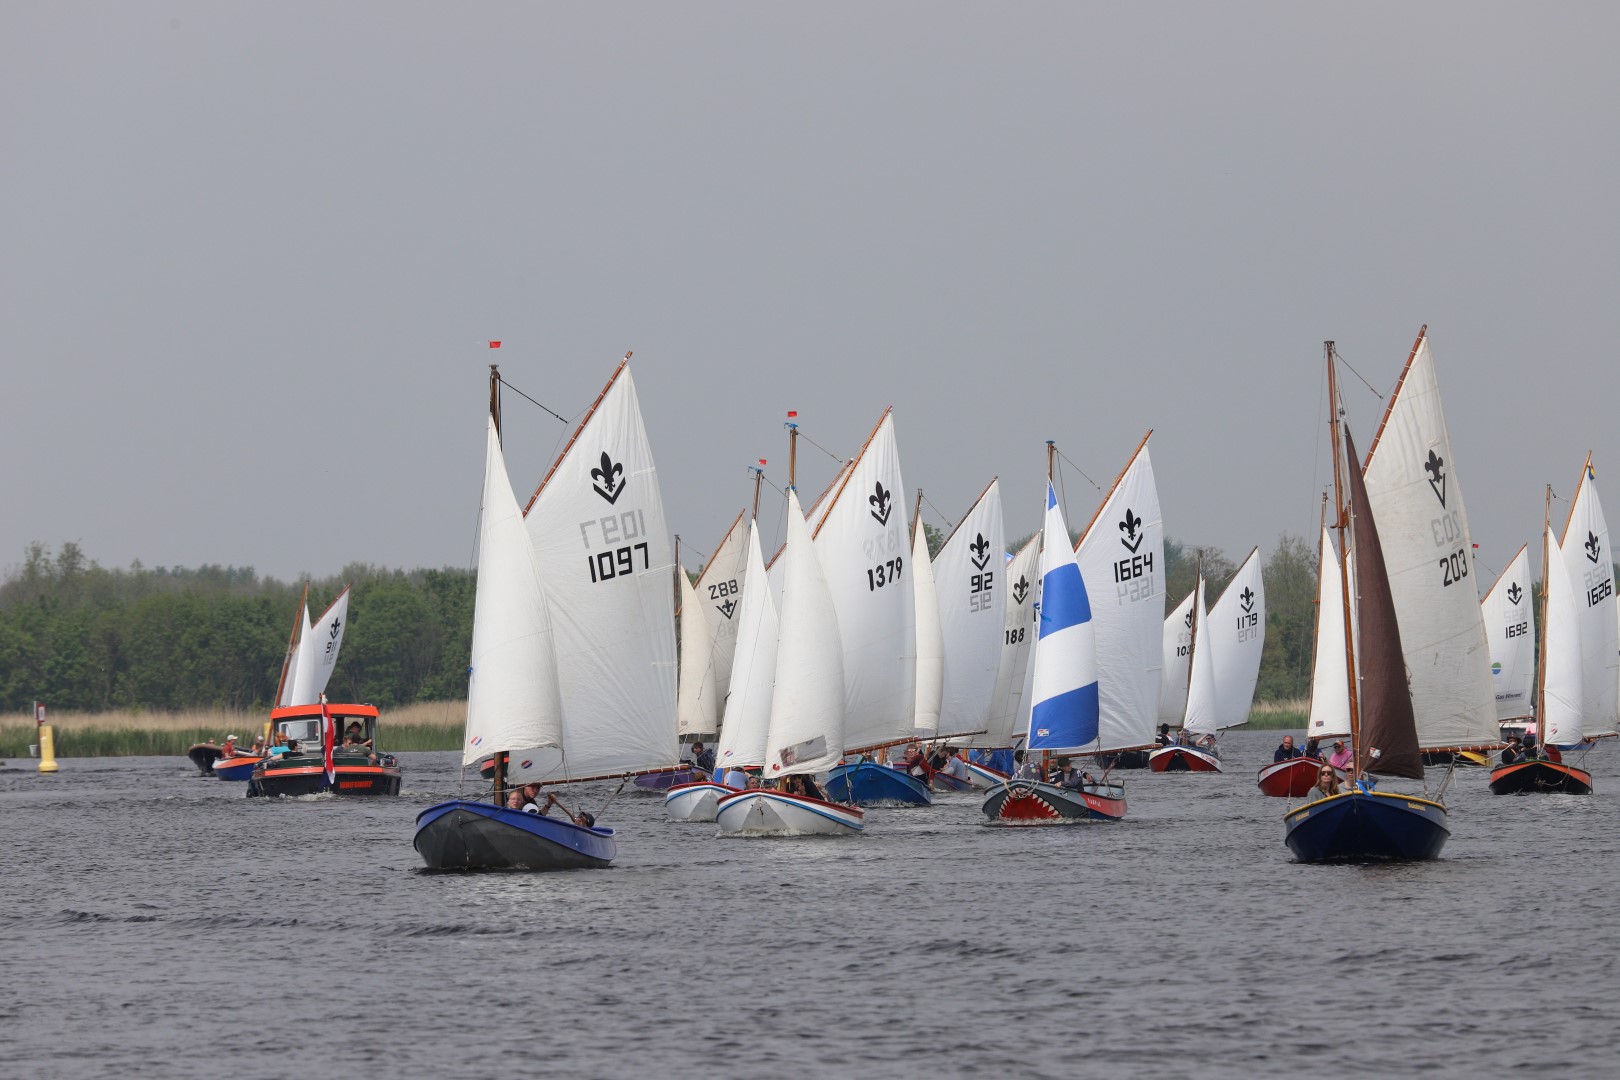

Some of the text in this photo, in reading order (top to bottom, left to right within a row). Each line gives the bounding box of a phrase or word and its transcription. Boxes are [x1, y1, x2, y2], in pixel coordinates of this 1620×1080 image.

[588, 542, 649, 583] 1097
[867, 556, 903, 591] 1379
[1114, 552, 1153, 583] 1664
[1440, 548, 1468, 587] 203
[708, 579, 738, 600] 288
[971, 571, 993, 593] 912
[1587, 578, 1611, 608] 1626
[1237, 612, 1258, 630] 1179
[1505, 621, 1528, 639] 1692
[1005, 627, 1025, 645] 188
